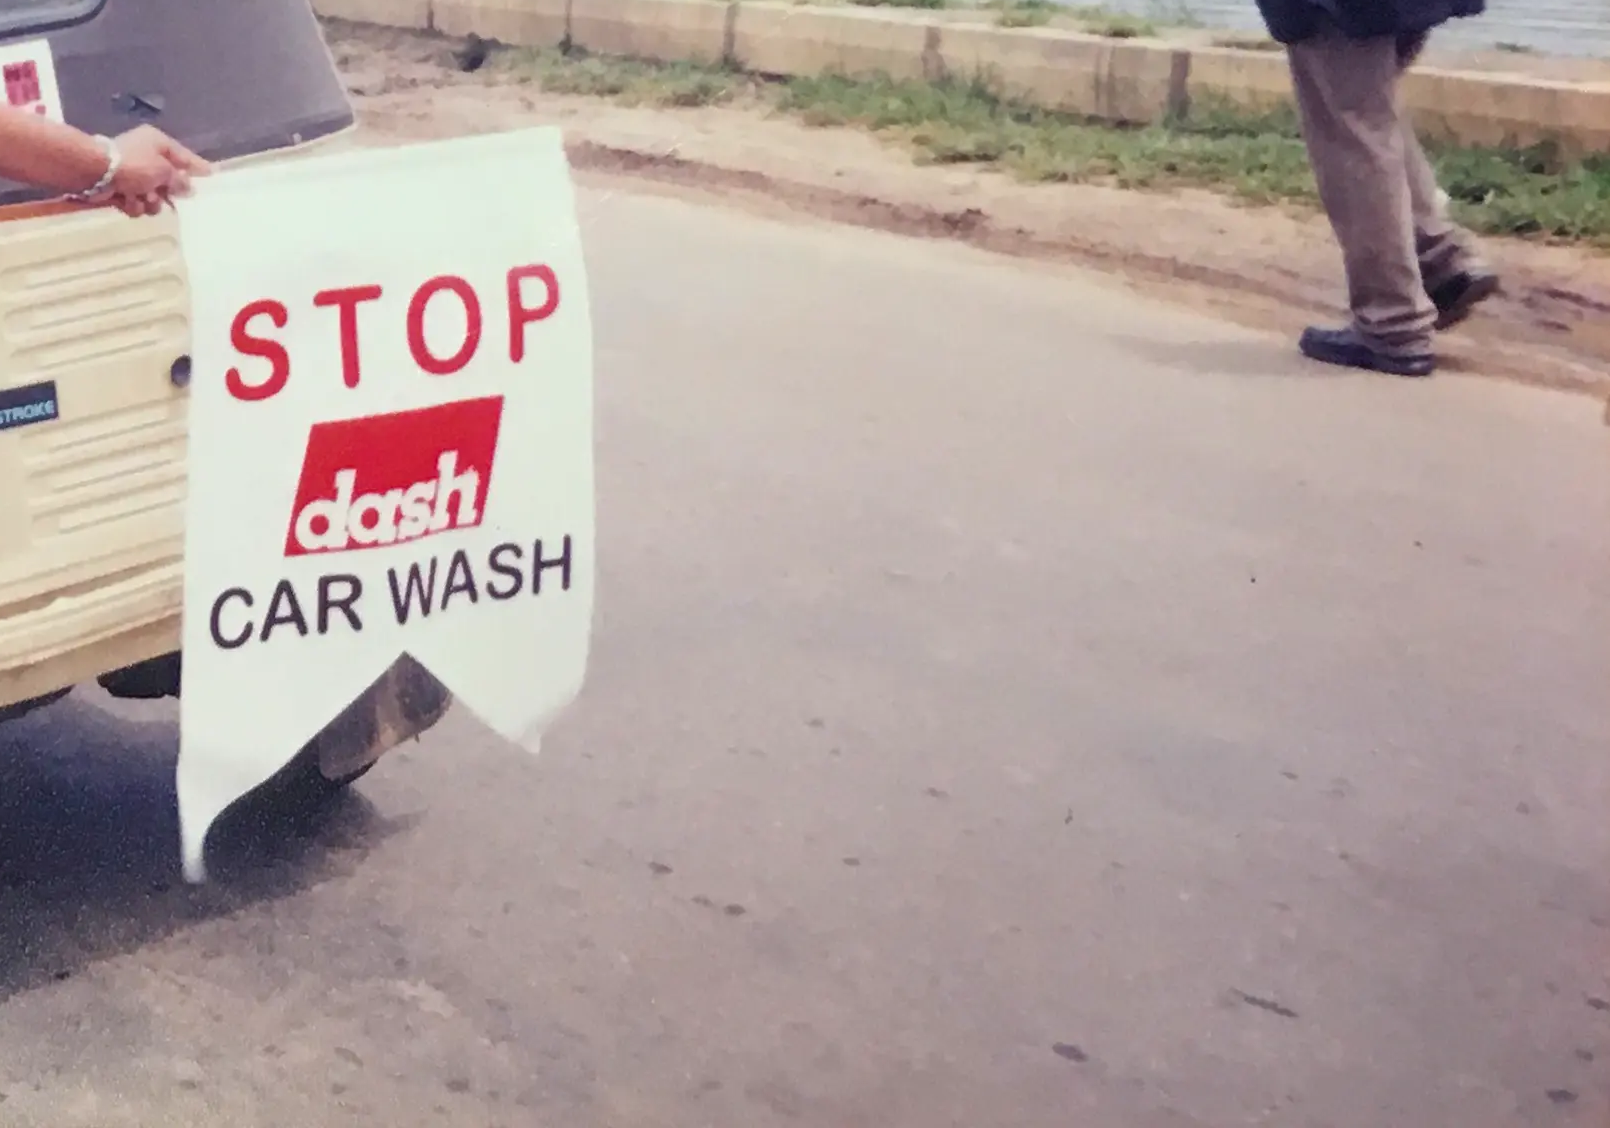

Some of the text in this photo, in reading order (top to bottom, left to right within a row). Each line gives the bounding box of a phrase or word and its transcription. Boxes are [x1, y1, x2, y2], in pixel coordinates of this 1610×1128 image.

[225, 263, 560, 402] STOP
[294, 449, 482, 549] dash
[208, 533, 573, 650] CAR WASH
